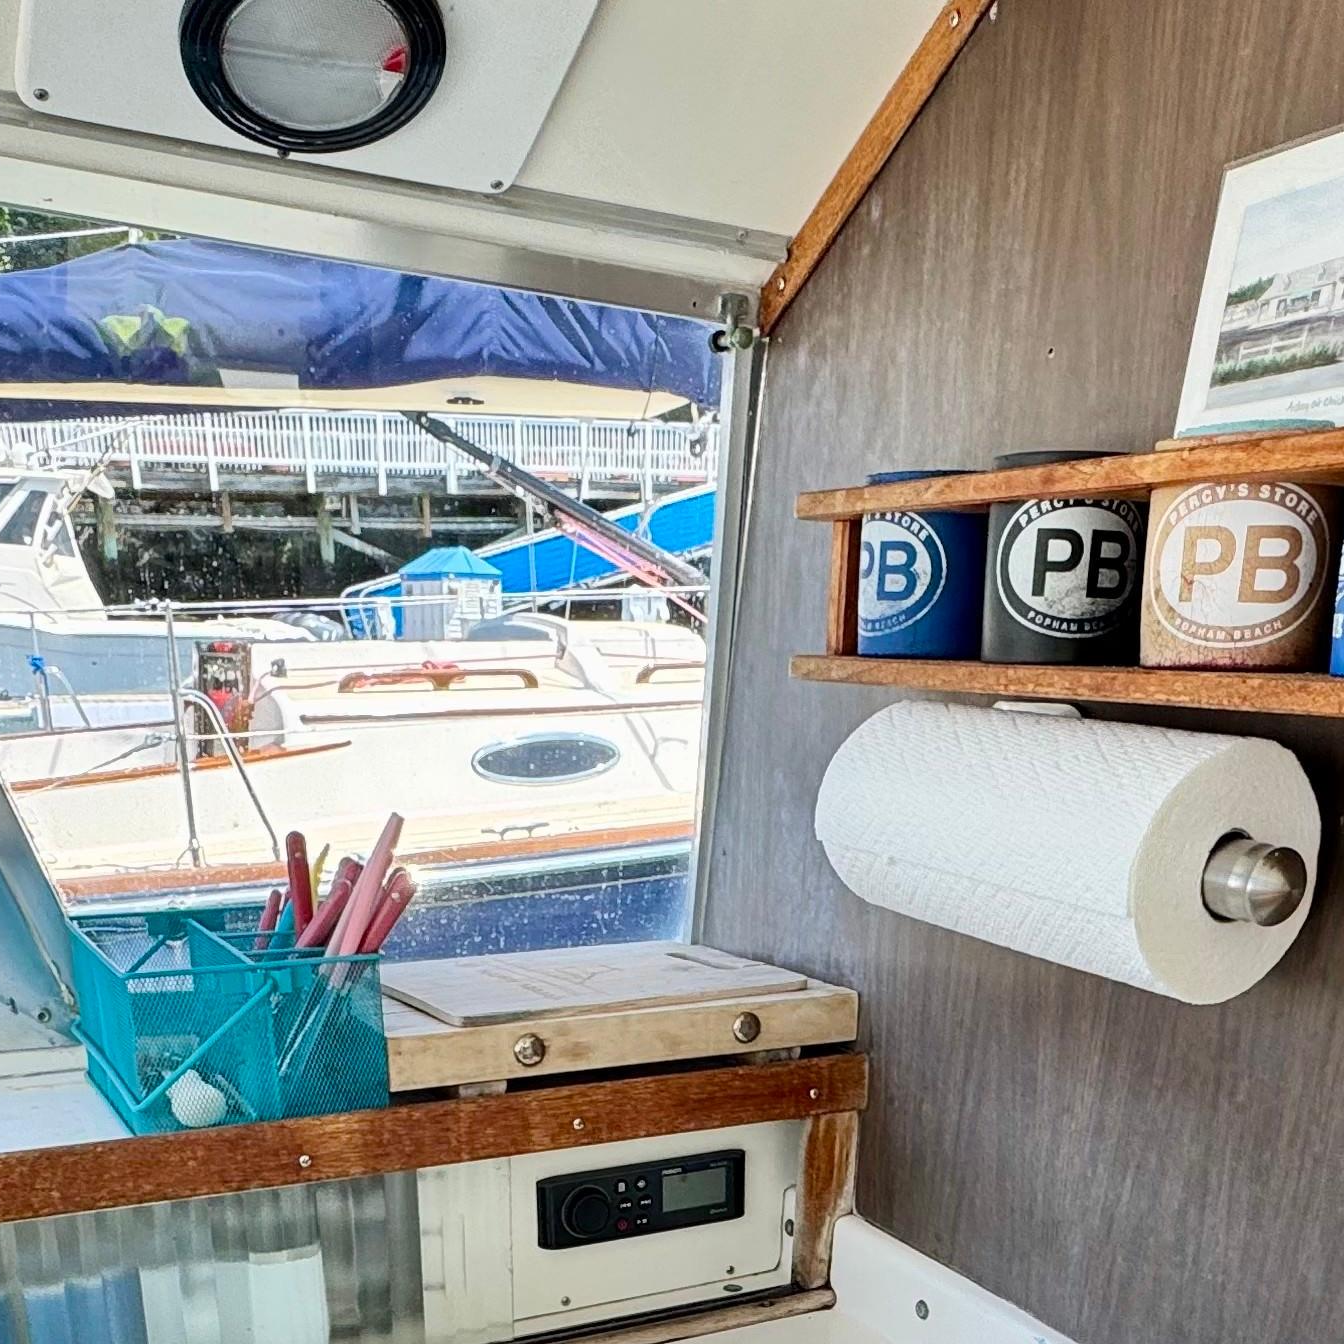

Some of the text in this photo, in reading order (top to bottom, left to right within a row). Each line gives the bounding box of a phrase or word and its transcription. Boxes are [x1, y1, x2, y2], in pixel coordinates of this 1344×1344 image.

[1018, 498, 1094, 528] PERC
[1168, 483, 1249, 526] PERCY'S
[1259, 484, 1318, 526] STORE
[1031, 528, 1130, 599] PB
[1178, 525, 1303, 603] PB
[1026, 610, 1078, 632] POPHAM
[1174, 617, 1283, 641] POPHAM BEACH
